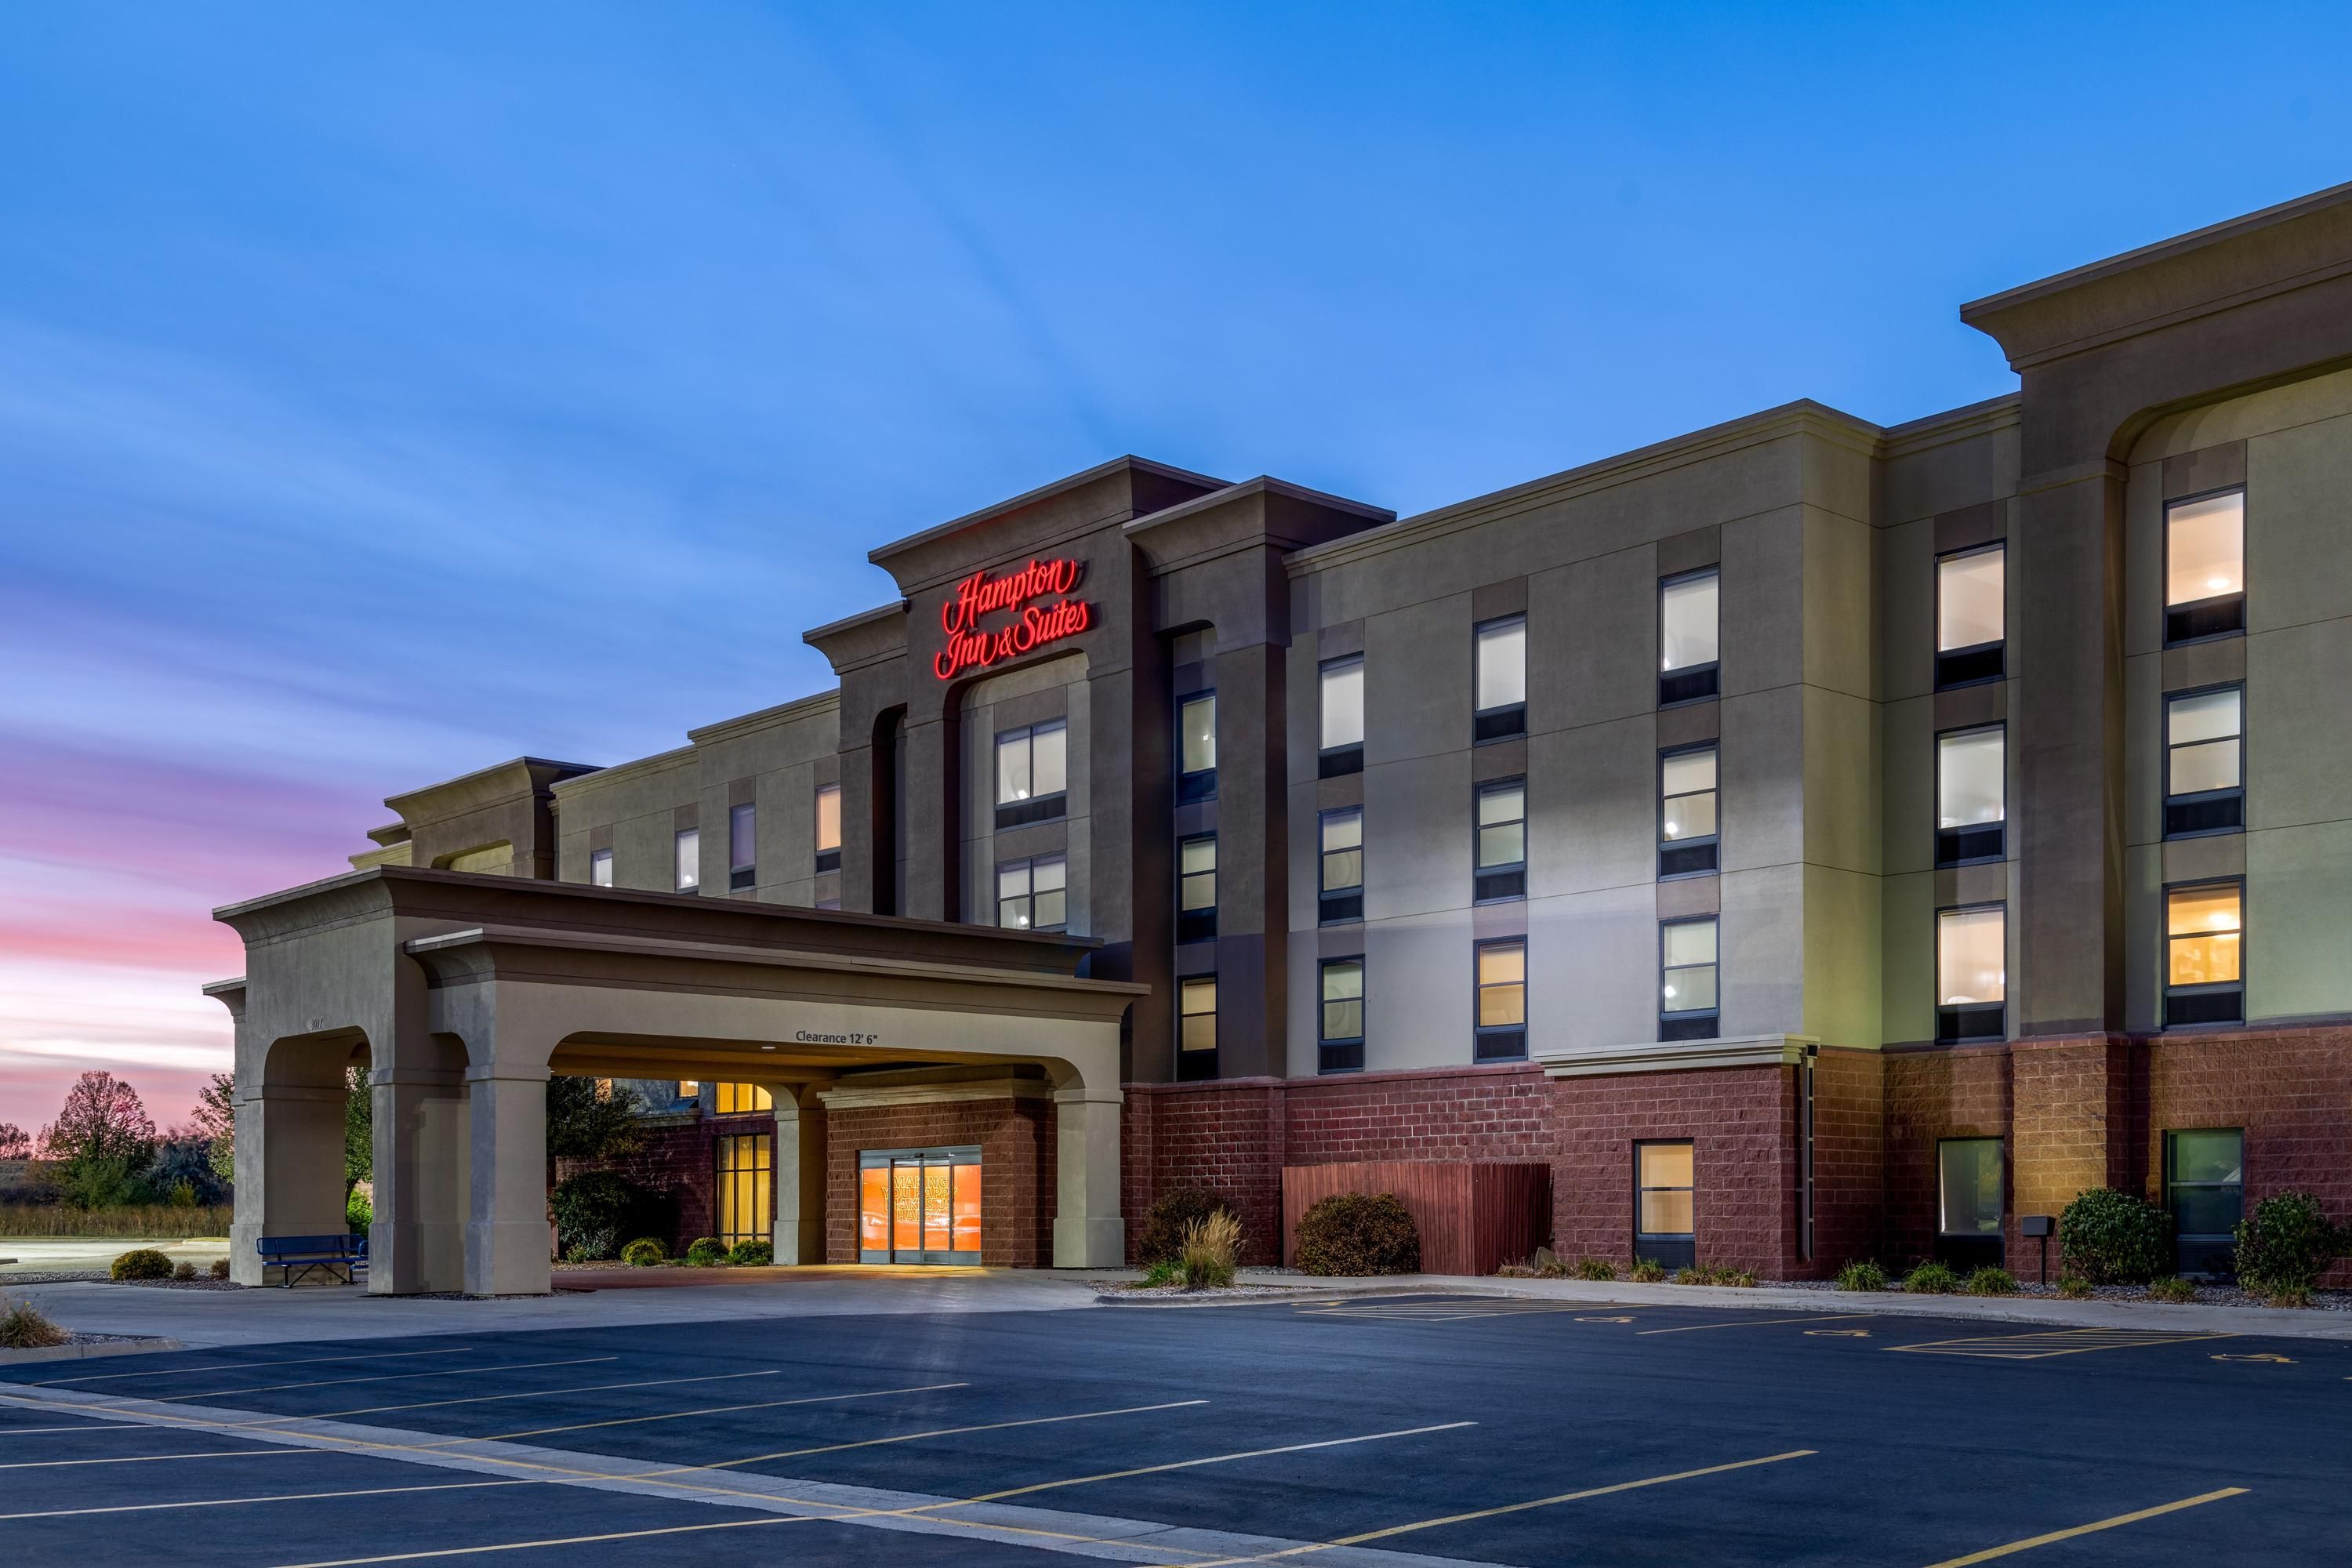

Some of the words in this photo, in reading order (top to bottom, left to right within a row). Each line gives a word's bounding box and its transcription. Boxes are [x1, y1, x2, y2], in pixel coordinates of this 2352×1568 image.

[943, 559, 1077, 635] Hampton
[935, 630, 998, 679] Inn
[998, 626, 1017, 657] &
[1014, 599, 1091, 651] Suites
[796, 1030, 847, 1044] Clearance
[849, 1033, 864, 1044] 12'
[866, 1034, 878, 1044] 6"
[892, 1175, 948, 1188] MAKING
[881, 1186, 910, 1199] YOU
[897, 1209, 940, 1221] HAPY
